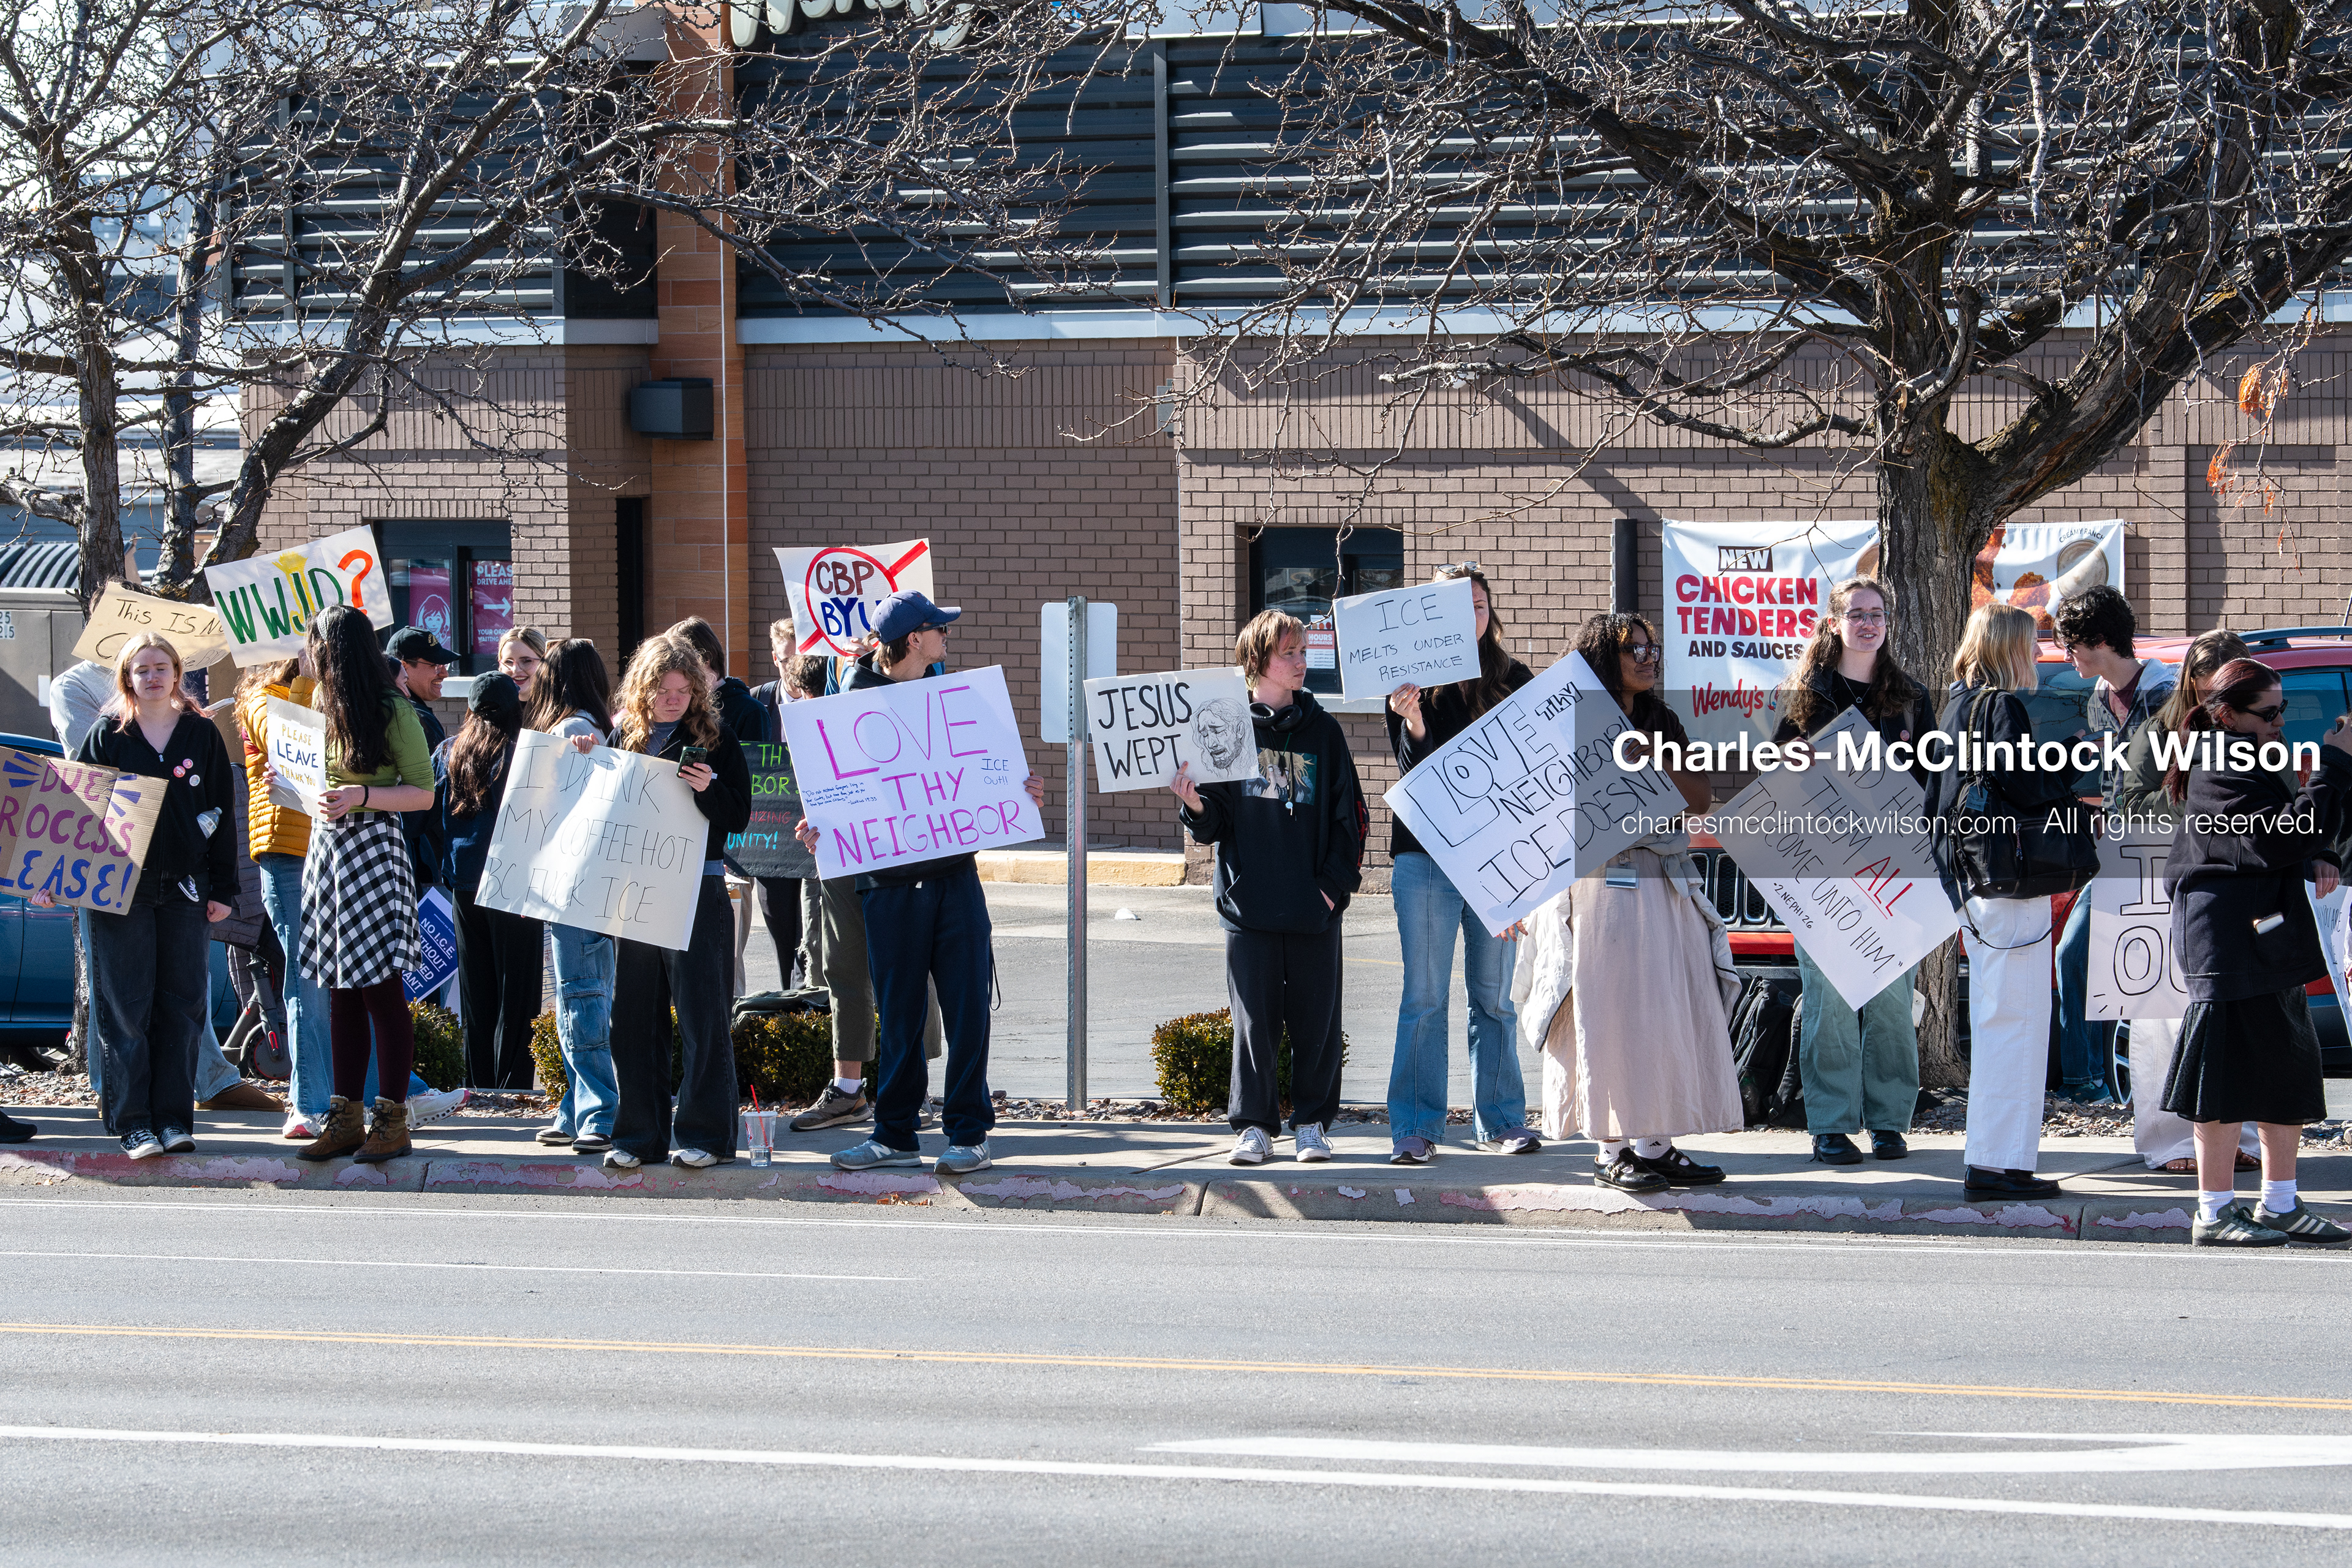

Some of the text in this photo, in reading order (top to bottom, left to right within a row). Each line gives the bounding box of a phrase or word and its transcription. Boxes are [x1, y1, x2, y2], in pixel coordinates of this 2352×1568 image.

[2059, 527, 2105, 543] CREAMY RANCH
[477, 564, 513, 578] PLEAS
[1720, 548, 1770, 570] NEW
[816, 560, 875, 596] CBP
[1676, 574, 1818, 605] CHICKEN
[116, 598, 152, 625] This
[161, 612, 197, 635] IS
[1374, 594, 1443, 632] ICE
[1676, 606, 1819, 639] TENDERS
[1349, 644, 1398, 664] MELTS
[1414, 633, 1464, 651] UNDER
[1688, 641, 1806, 660] AND SAUCES
[1379, 655, 1463, 682] RESISTANCE
[1098, 682, 1192, 731] JESUS
[1692, 679, 1764, 718] Wendy's
[282, 723, 312, 746] PLEASE
[816, 685, 988, 780] LOVE
[277, 739, 318, 768] LEAVE
[981, 759, 1009, 772] ICE
[1102, 733, 1182, 780] WEPT
[39, 761, 104, 801] DUE
[279, 764, 315, 786] THANK YOU
[510, 745, 660, 813] I DRINK
[752, 774, 791, 796] BOR
[881, 767, 965, 811] THY
[984, 775, 1009, 786] Out!!
[1404, 700, 1559, 848] LOVE
[0, 795, 135, 858] ROCESS
[500, 804, 694, 874] MY COFFEE HOT
[727, 831, 778, 850] UNITY!
[833, 800, 1027, 867] NEIGHBOR
[1738, 780, 1777, 827] TO
[1765, 823, 1824, 884] COME
[1811, 876, 1862, 931] UNTO
[1802, 775, 1913, 918] THEM ALL
[483, 857, 657, 923] BC FUCK ICE
[1781, 892, 1804, 917] NEPHI
[1801, 915, 1814, 929] 26
[421, 918, 436, 934] NO
[434, 932, 455, 959] I.C.E.
